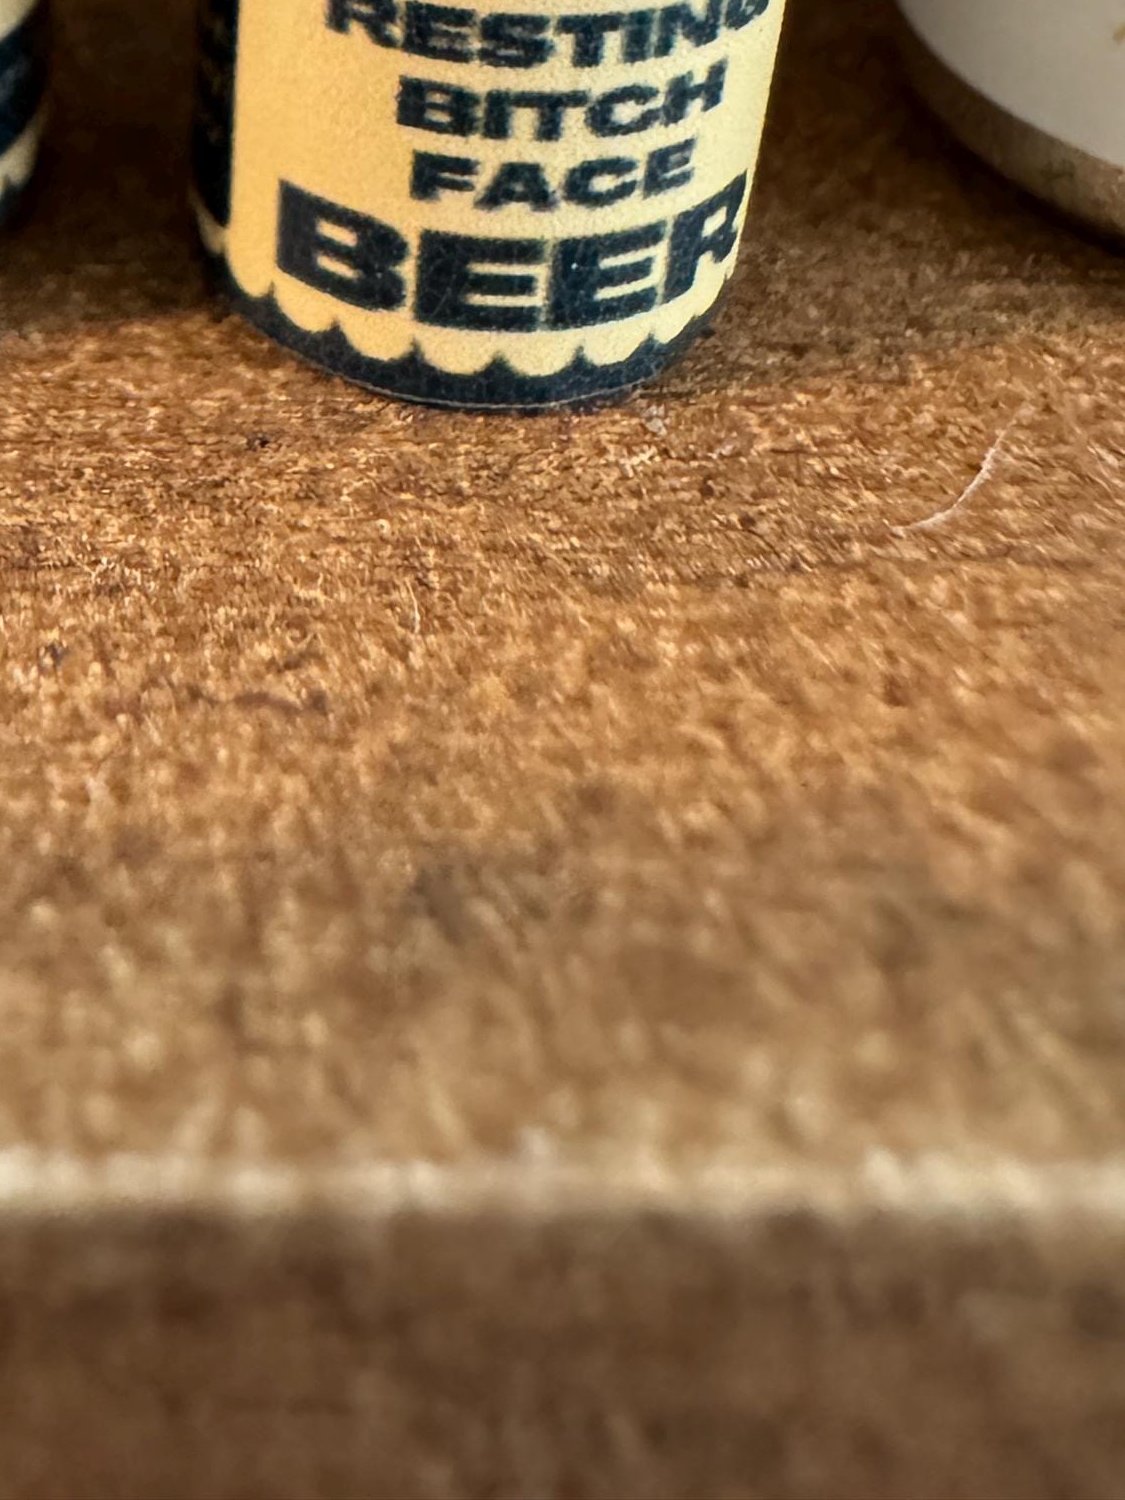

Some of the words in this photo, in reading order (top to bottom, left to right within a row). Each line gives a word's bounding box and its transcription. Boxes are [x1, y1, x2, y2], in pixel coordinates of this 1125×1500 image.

[396, 58, 728, 141] BITCH
[410, 137, 696, 210] FACE
[277, 169, 747, 332] BEER
